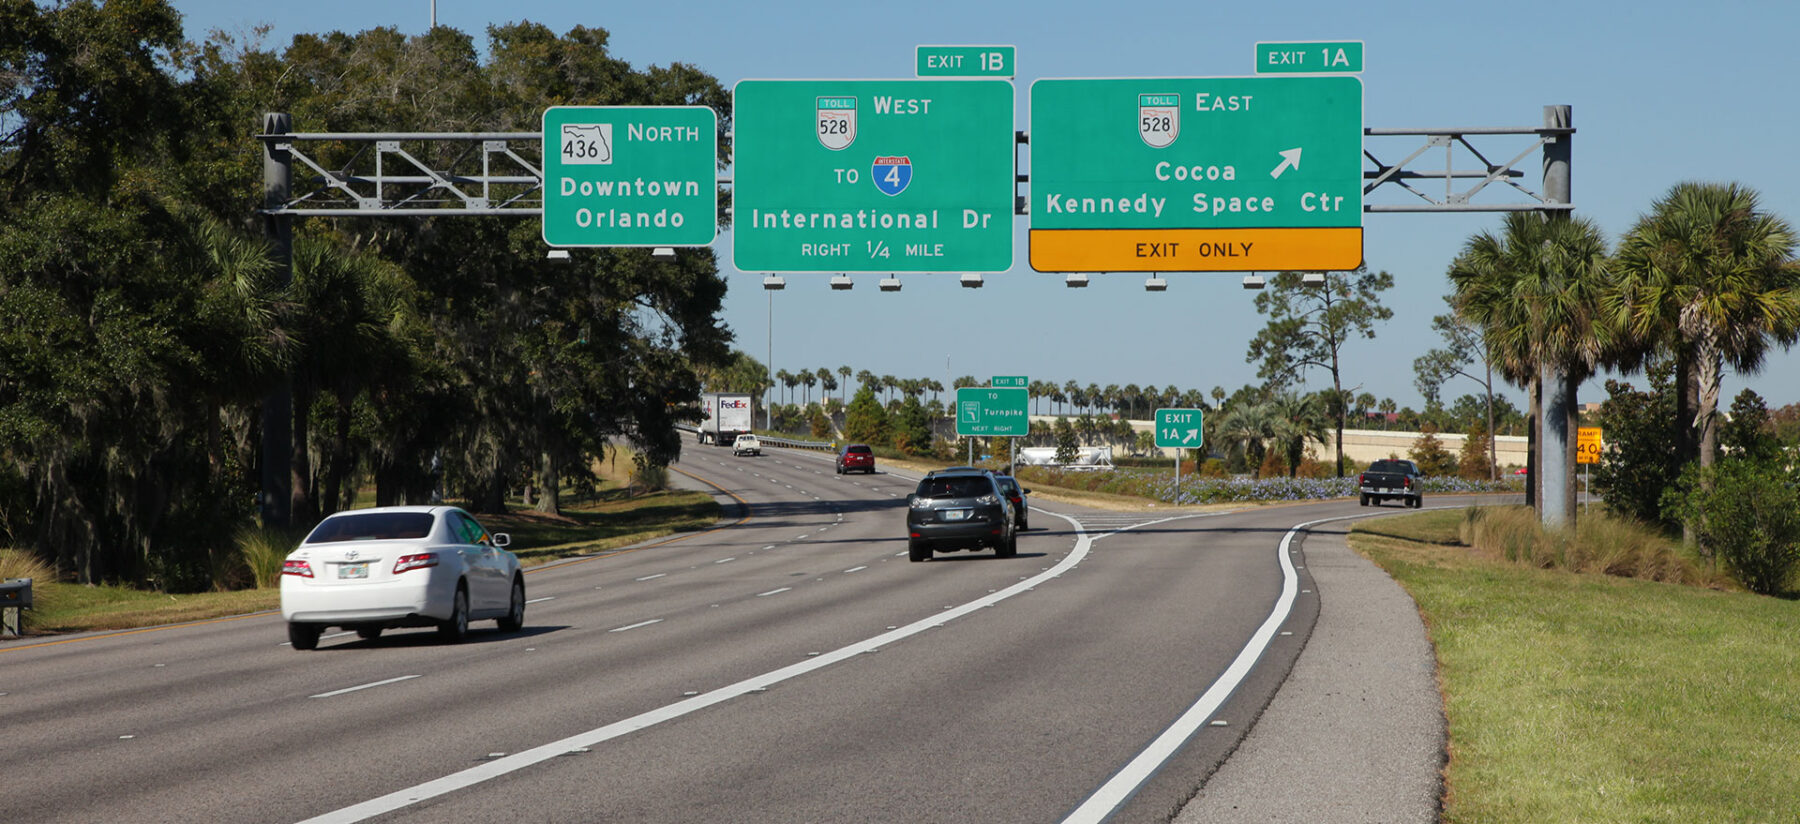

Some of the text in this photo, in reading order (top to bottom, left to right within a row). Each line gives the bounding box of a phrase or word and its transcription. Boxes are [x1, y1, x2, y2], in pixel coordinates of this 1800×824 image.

[927, 52, 1004, 71] EXIT 1B
[1268, 48, 1350, 67] EXIT 1A
[824, 99, 850, 108] TOLL
[1146, 96, 1173, 106] TOLL
[819, 119, 848, 135] 528
[1142, 117, 1171, 133] 528
[563, 140, 598, 158] 436
[878, 157, 906, 165] INTERSTATE
[834, 169, 859, 184] TO
[884, 166, 900, 187] 4
[1155, 161, 1236, 182] Cocoa
[561, 177, 699, 197] Downtown
[1046, 191, 1344, 218] Kennedy Space Ctr
[575, 208, 684, 228] Orlando
[753, 209, 992, 229] International Dr
[801, 243, 851, 257] RIGHT
[905, 244, 944, 257] MILE
[1136, 242, 1254, 258] EXIT ONLY
[721, 400, 747, 408] FedEx
[984, 408, 1023, 416] Turnpike
[1165, 414, 1192, 423] EXIT
[1162, 428, 1179, 439] 1A
[1577, 443, 1597, 454] 40
